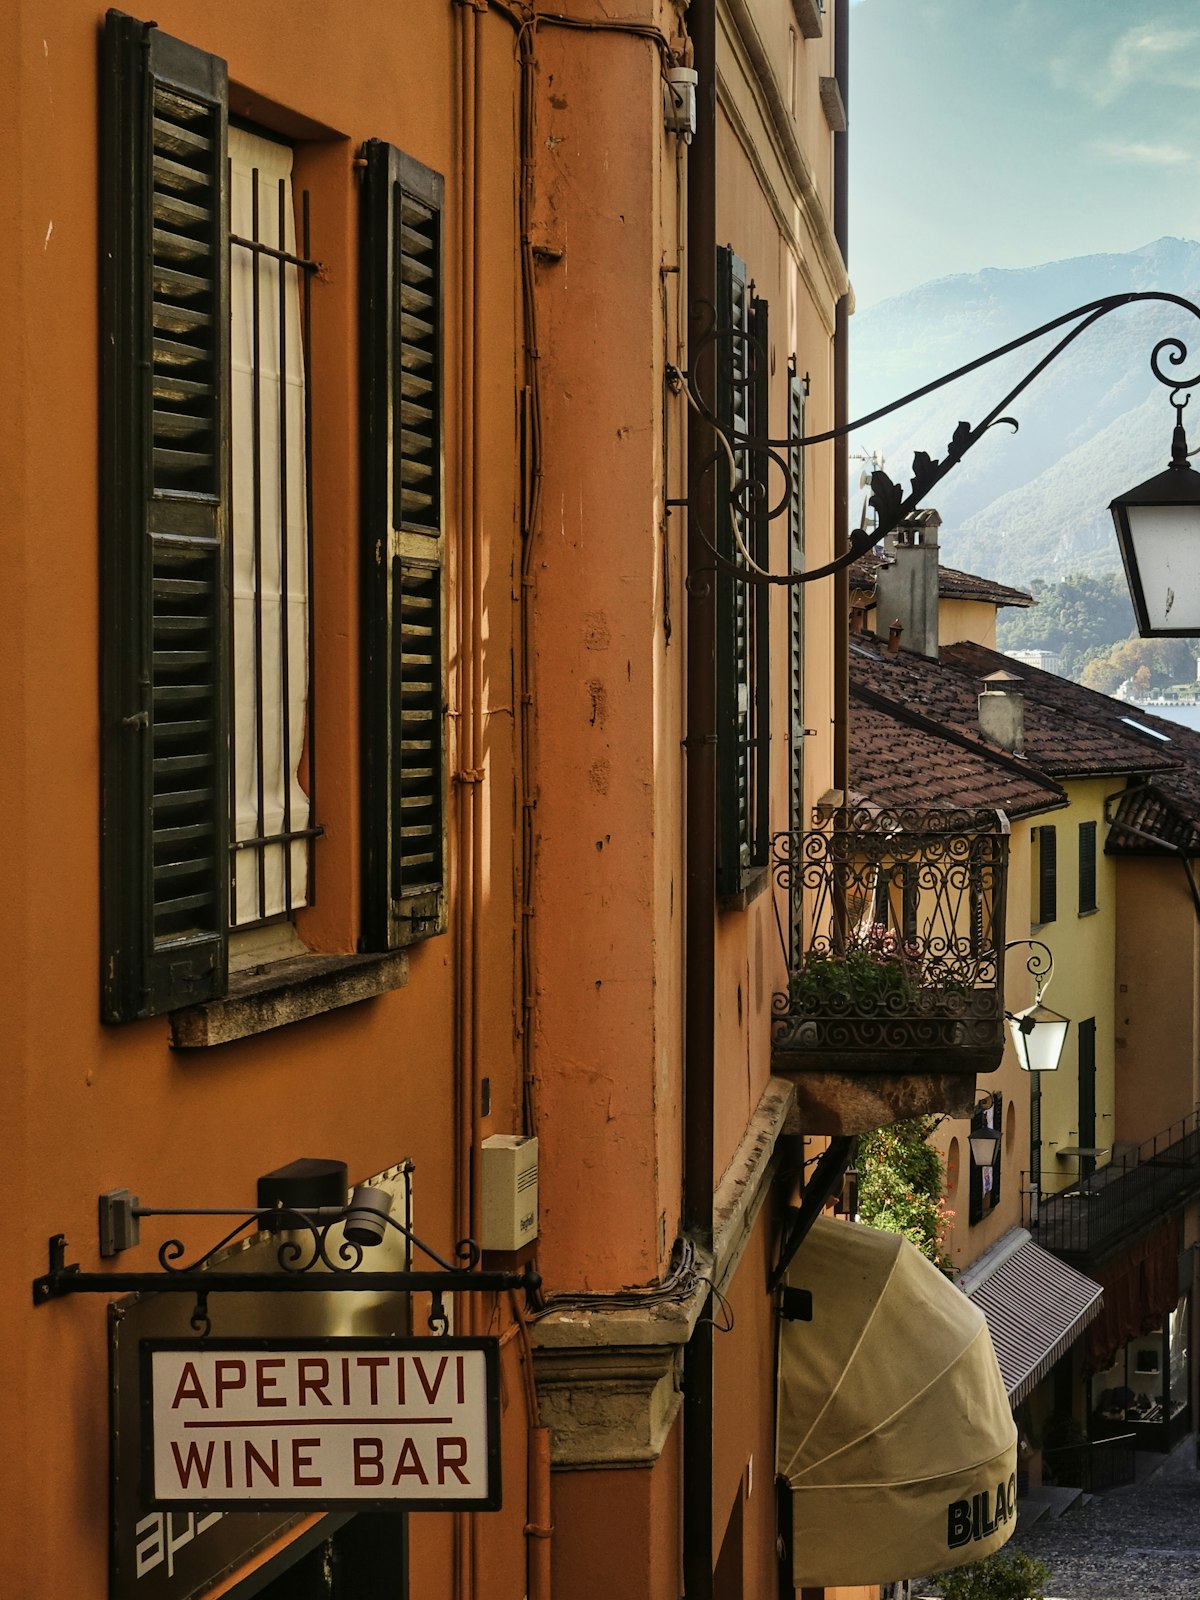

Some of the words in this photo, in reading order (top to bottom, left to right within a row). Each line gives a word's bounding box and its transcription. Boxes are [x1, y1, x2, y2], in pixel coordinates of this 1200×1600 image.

[171, 1356, 465, 1409] APERITIVI
[170, 1438, 323, 1489] WINE
[353, 1436, 471, 1486] BAR
